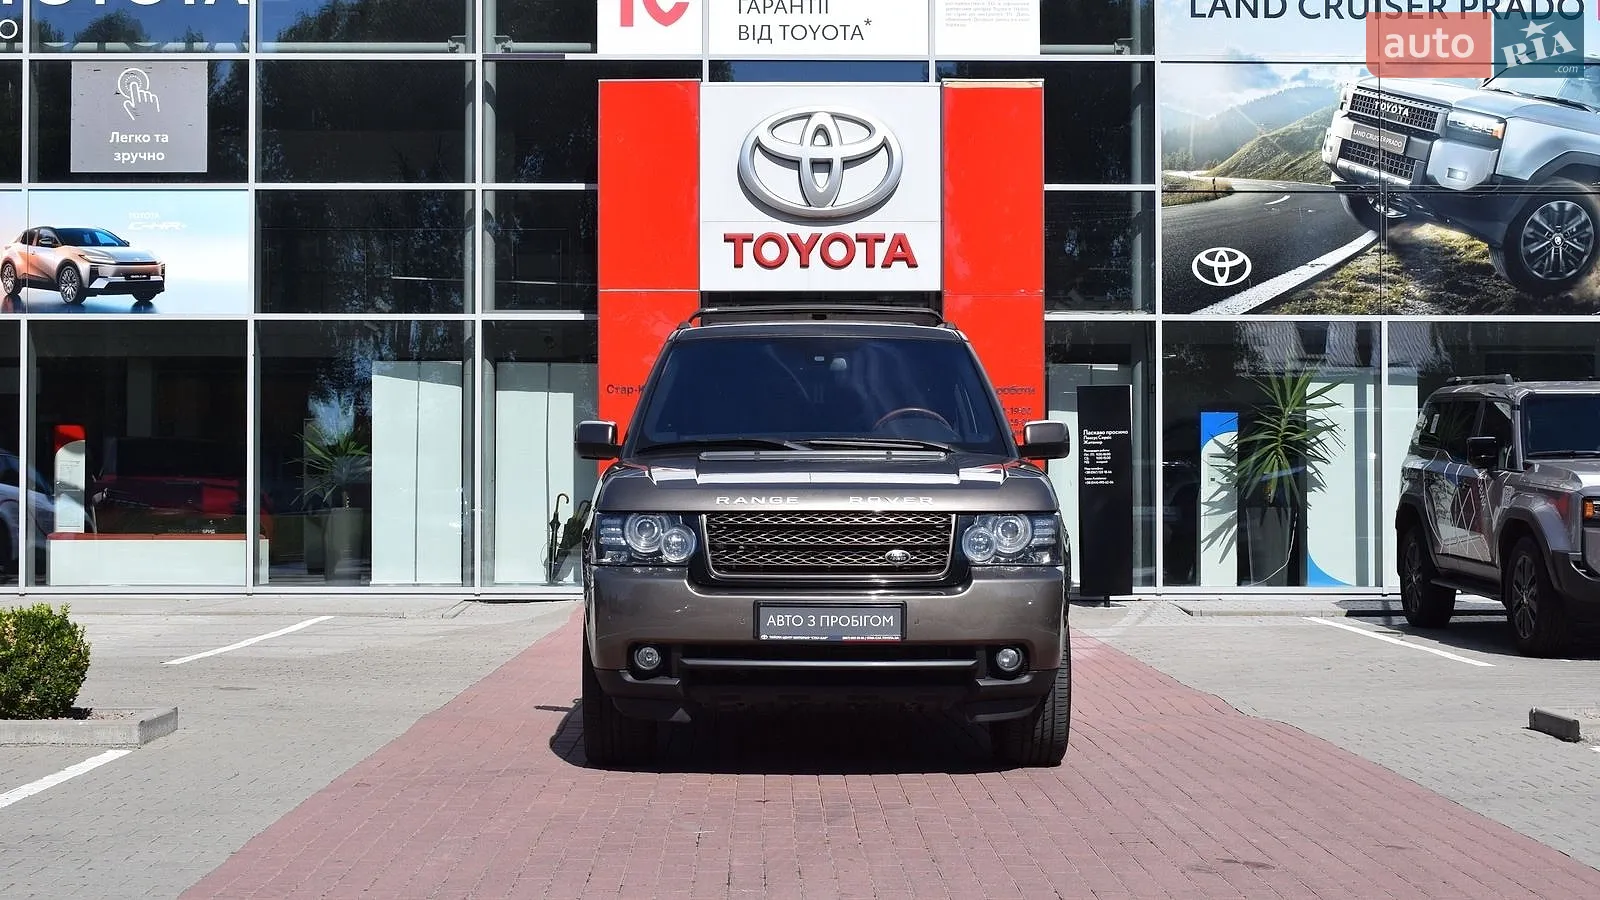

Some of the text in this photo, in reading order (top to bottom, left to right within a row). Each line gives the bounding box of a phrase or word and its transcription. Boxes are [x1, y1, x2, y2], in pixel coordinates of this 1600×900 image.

[1190, 0, 1585, 21] LAND CRUISER PRADO
[738, 24, 772, 44] ВІД
[1374, 100, 1409, 117] TOYOTA
[109, 131, 169, 143] Легко та
[1352, 129, 1366, 138] LAND
[113, 152, 165, 164] зручно
[723, 231, 919, 270] TOYOTA
[715, 496, 934, 505] RANGE ROVER
[766, 614, 804, 627] АВТО
[820, 615, 894, 627] ПРОБІГОМ
